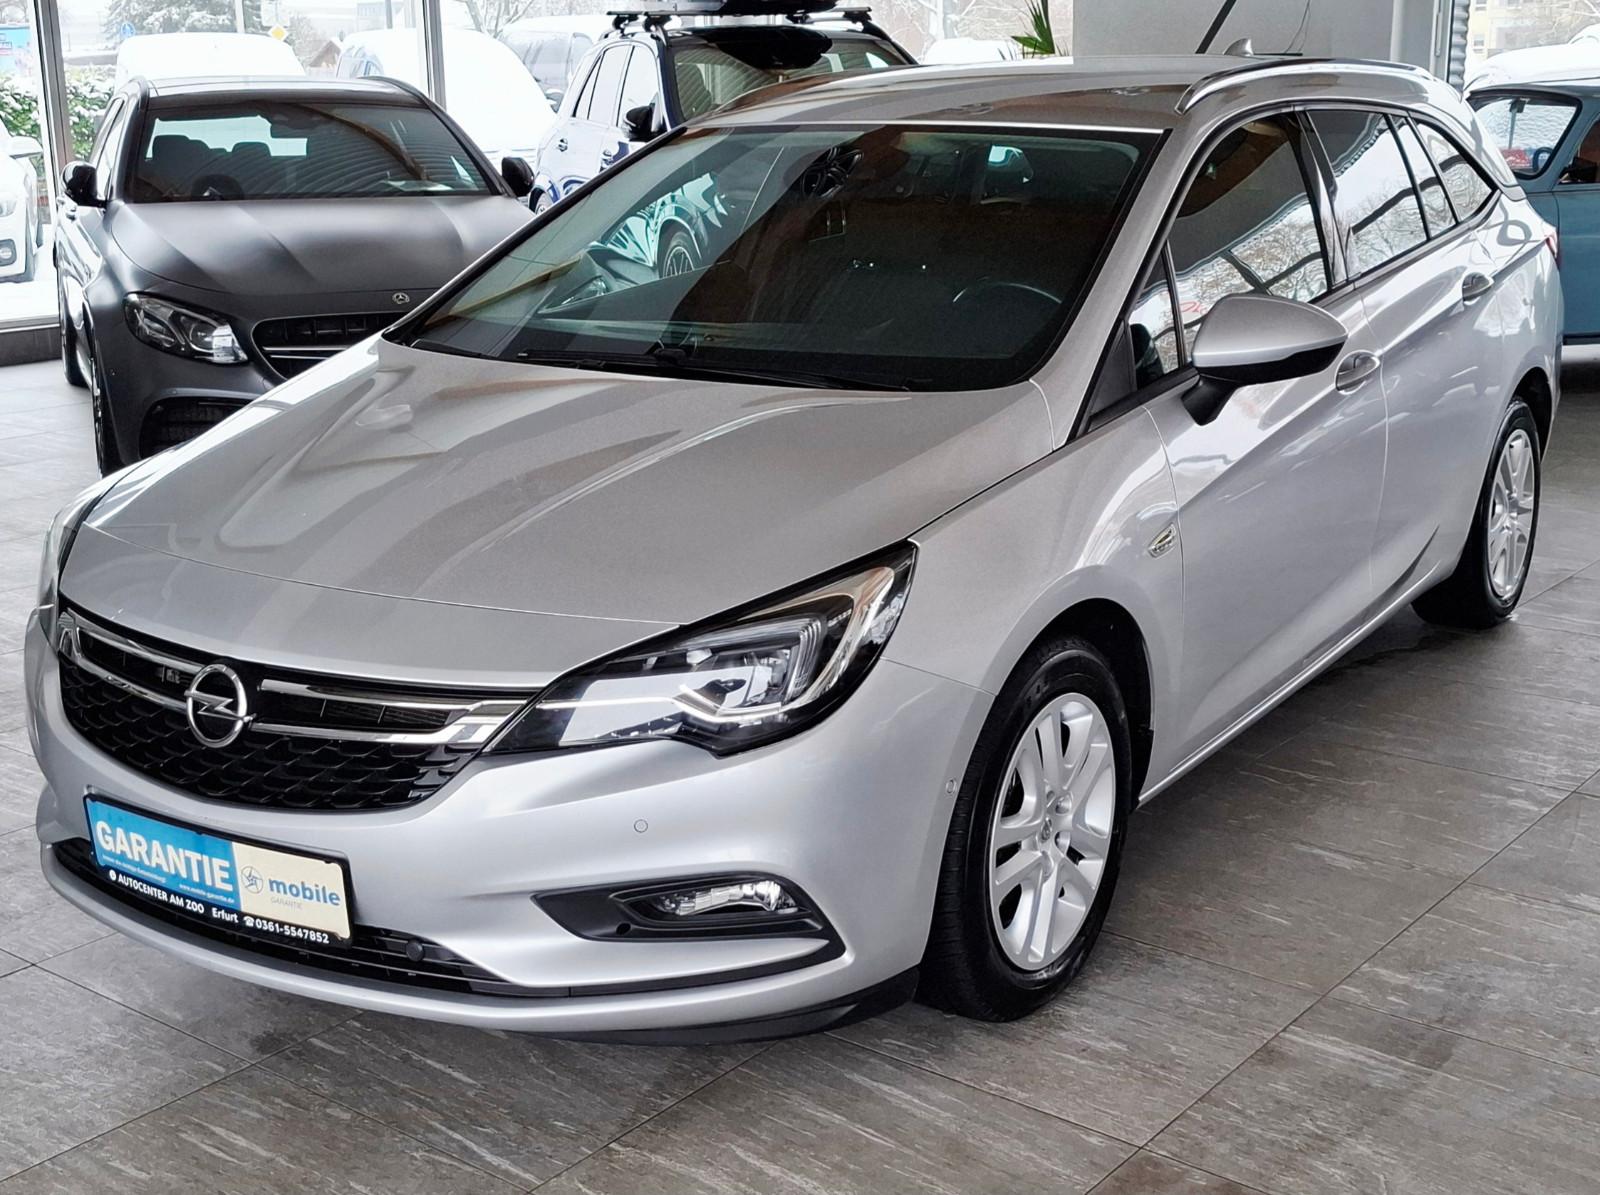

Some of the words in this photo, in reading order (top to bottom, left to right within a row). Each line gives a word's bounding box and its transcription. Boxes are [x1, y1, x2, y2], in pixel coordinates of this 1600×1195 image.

[95, 821, 233, 892] GARANTIE
[268, 877, 341, 906] mobile
[118, 873, 167, 902] AUTOCENTER
[170, 894, 184, 907] AM
[186, 899, 204, 914] ZOO
[212, 907, 239, 923] Erfurt
[255, 918, 330, 944] 0361-5547852
